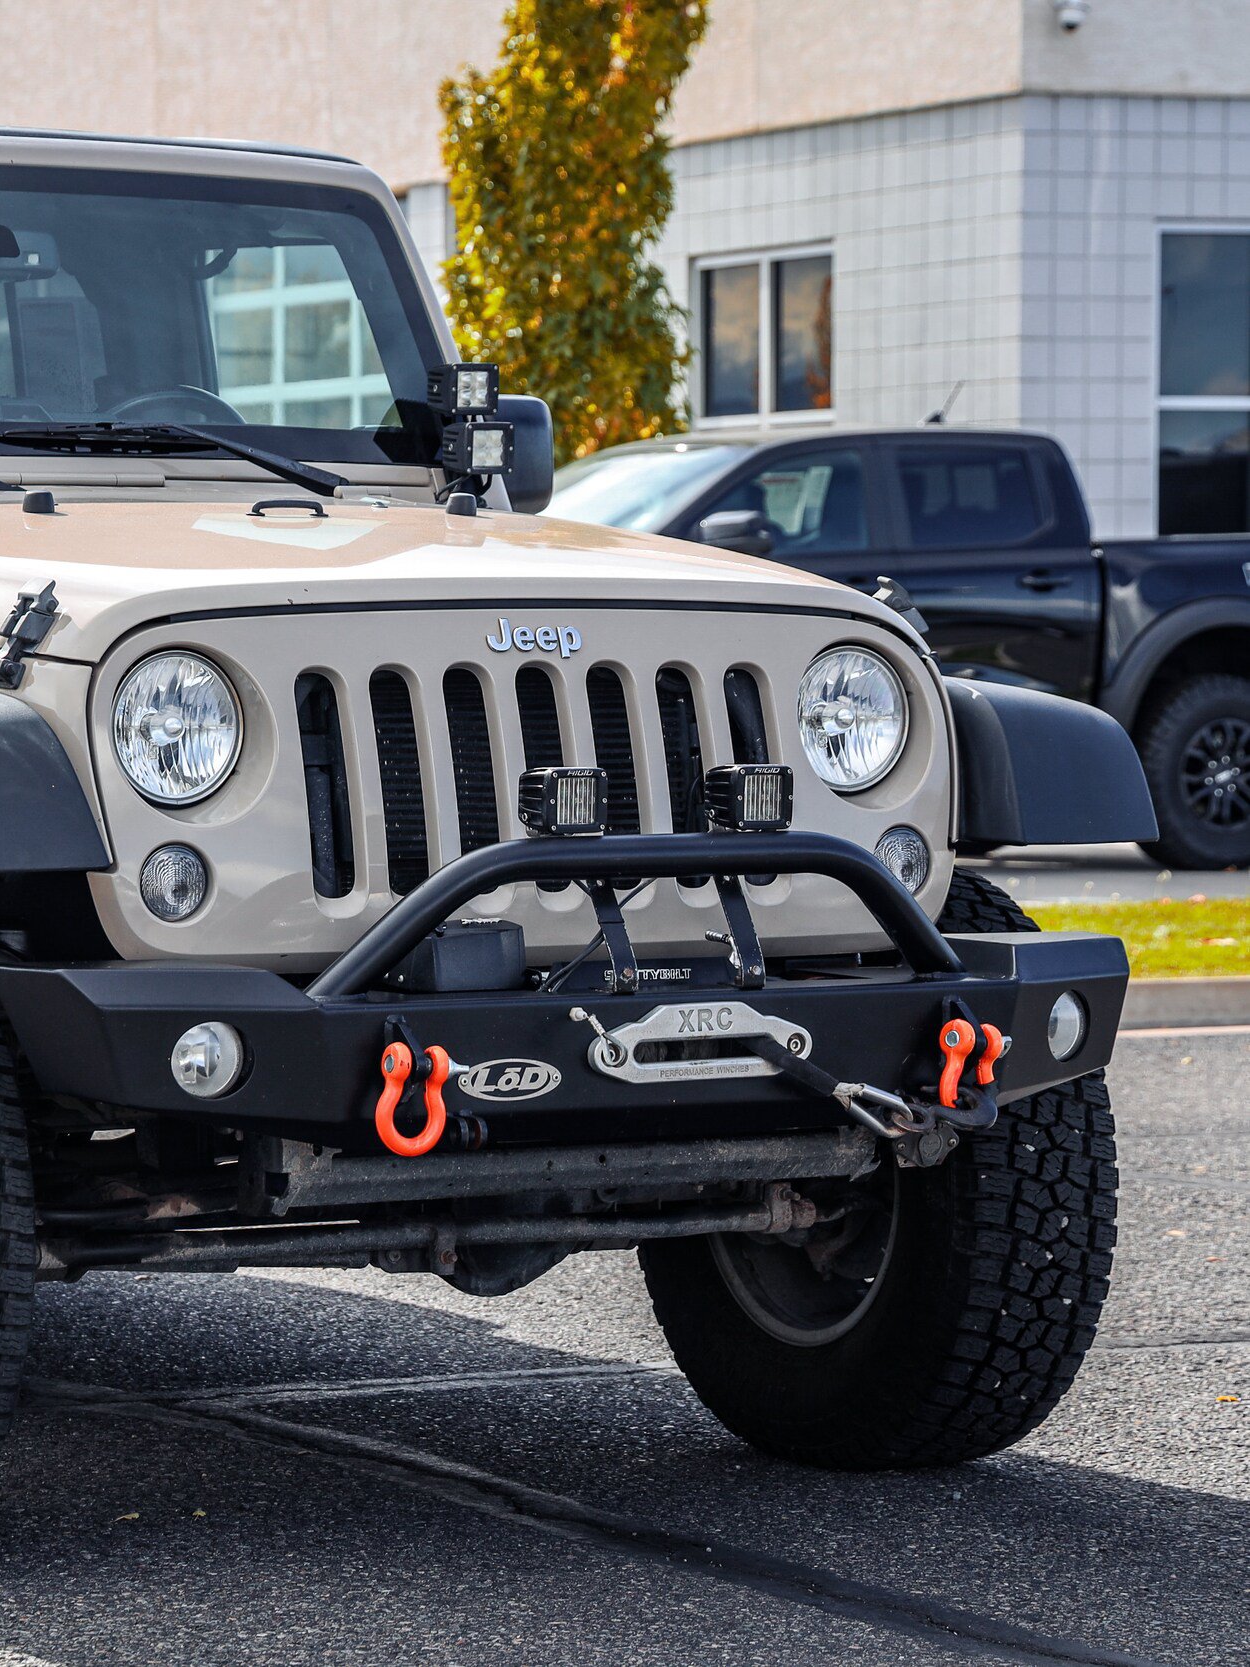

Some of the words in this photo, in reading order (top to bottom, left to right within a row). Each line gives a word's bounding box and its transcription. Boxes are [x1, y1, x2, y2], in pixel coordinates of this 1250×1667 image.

[486, 617, 582, 659] Jeep
[603, 967, 692, 982] STYBILT
[678, 1007, 734, 1033] XRC
[659, 1067, 714, 1079] PERFORMANCE
[716, 1065, 750, 1075] WINCHES
